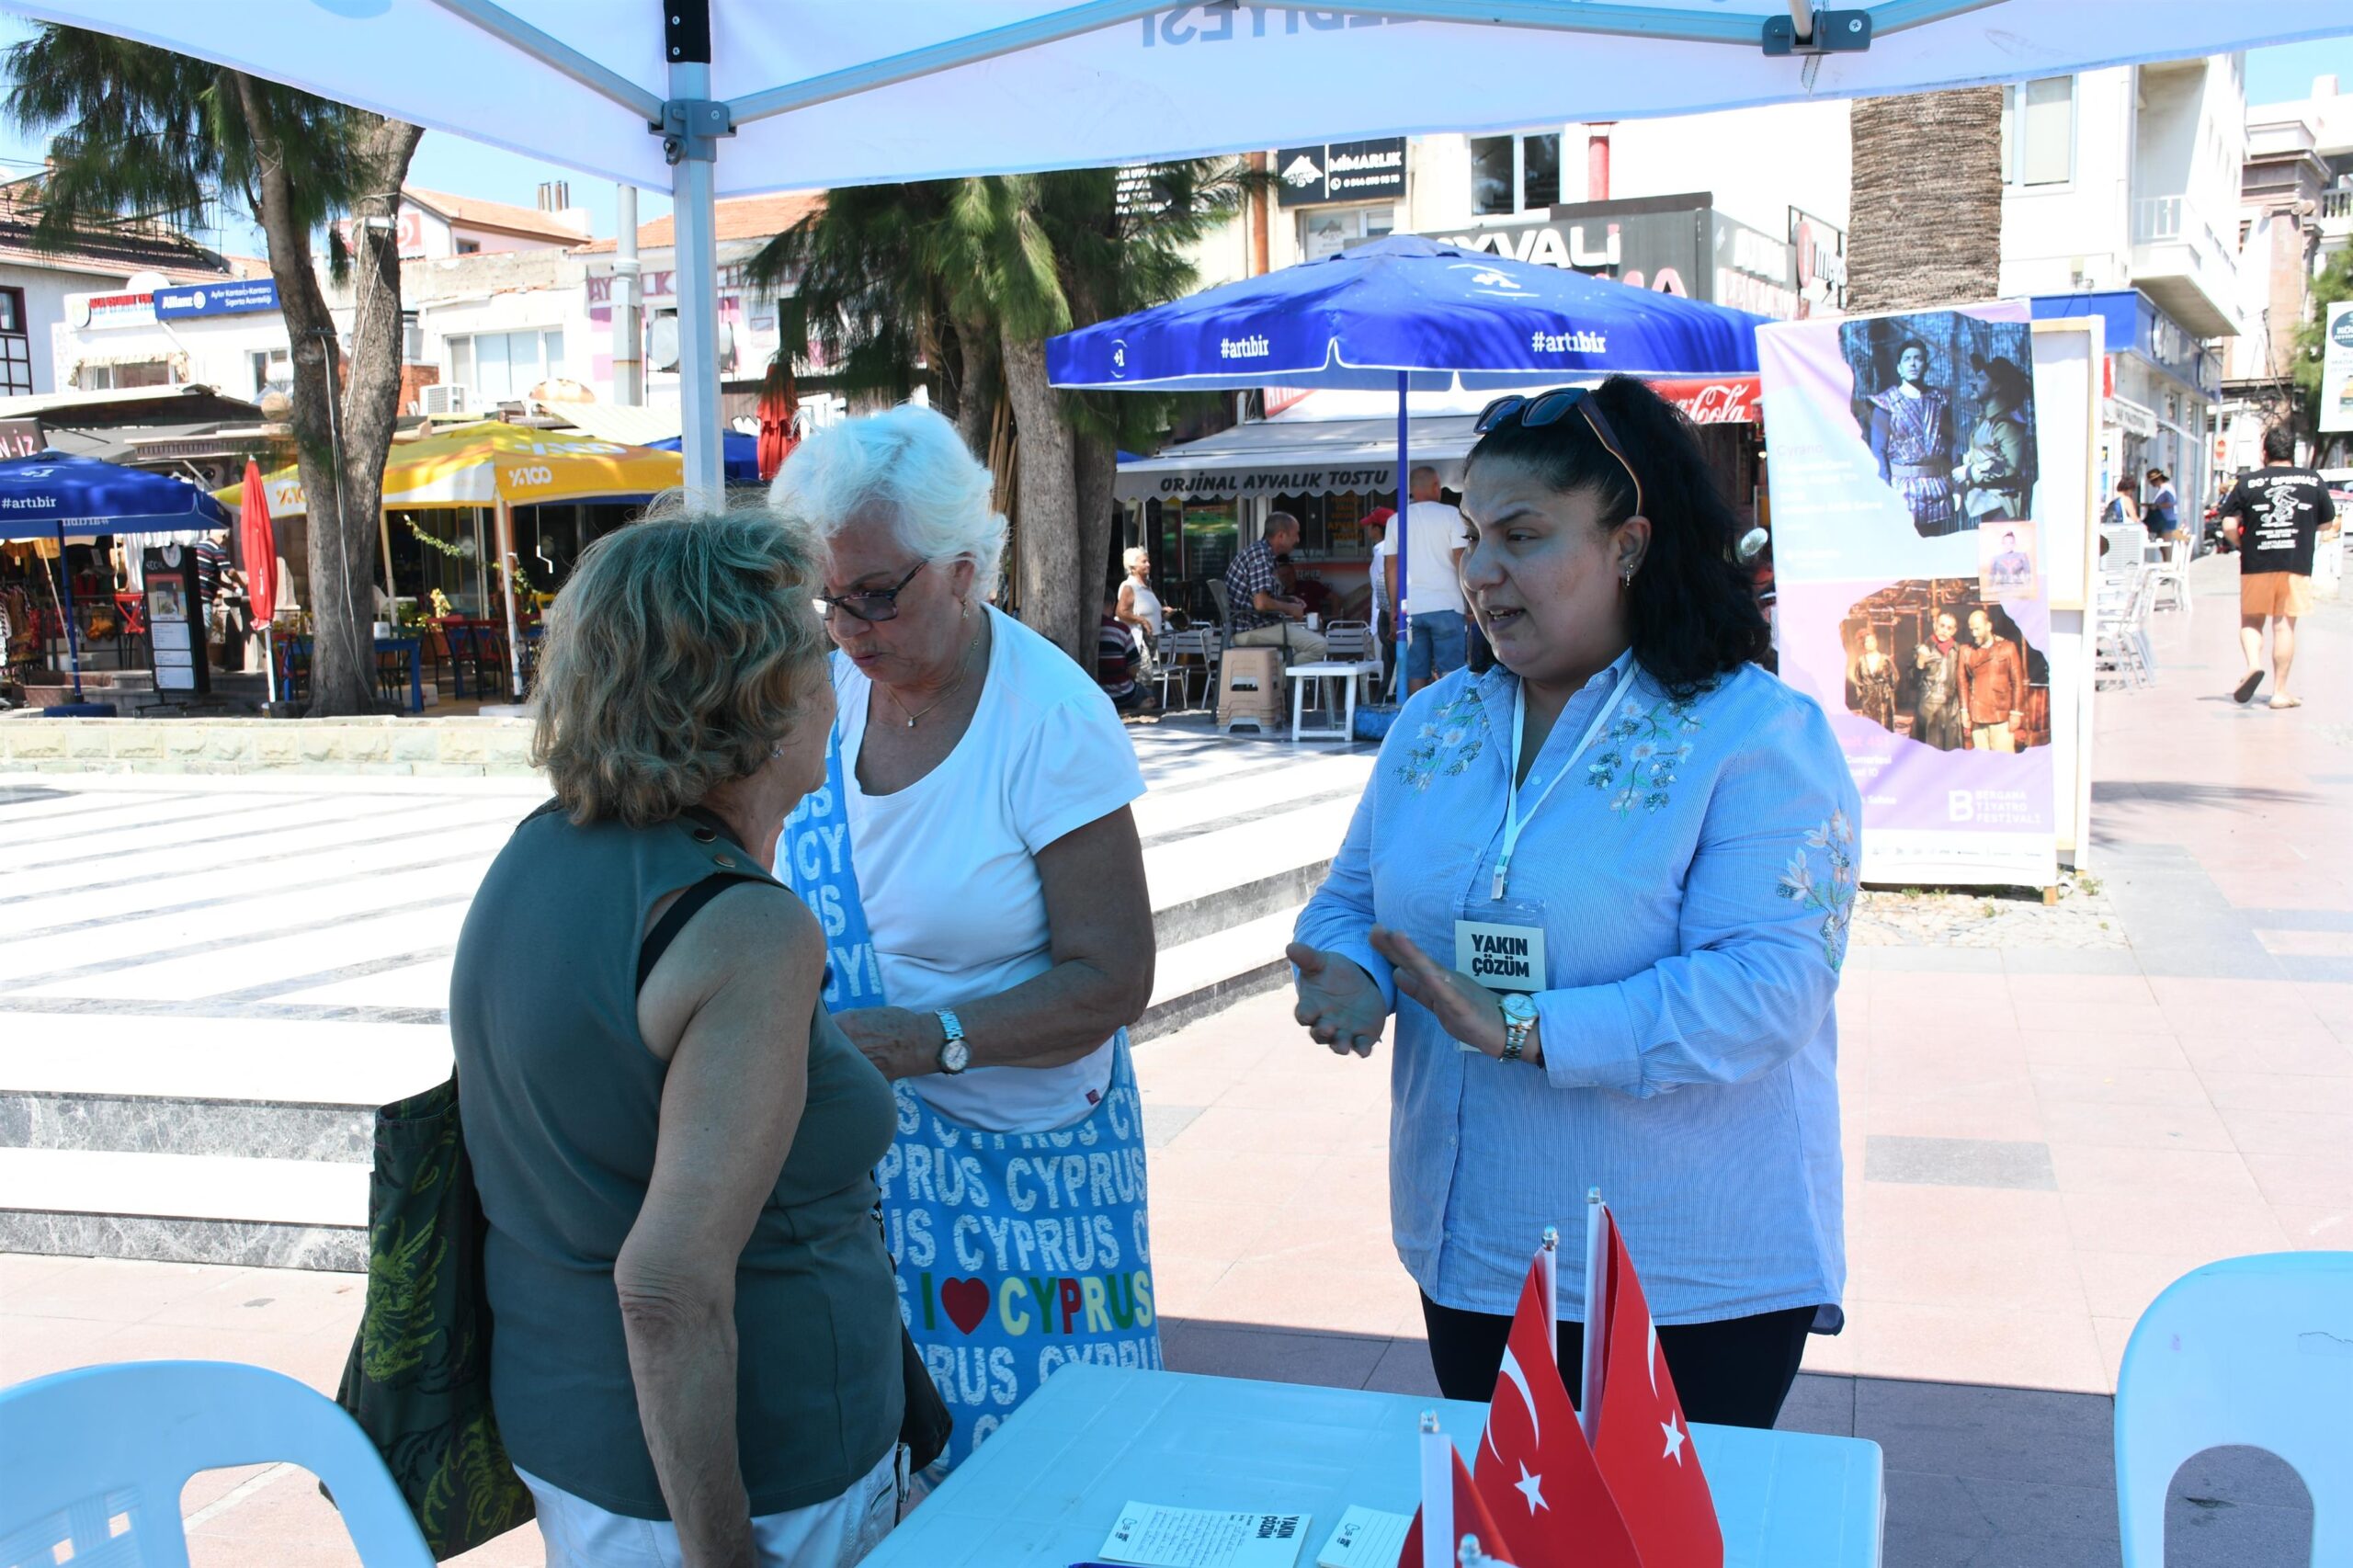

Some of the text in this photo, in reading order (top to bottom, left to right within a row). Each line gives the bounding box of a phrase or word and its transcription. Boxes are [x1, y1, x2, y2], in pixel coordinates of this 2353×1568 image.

[1329, 152, 1402, 173] MİMARLIK
[162, 296, 193, 309] Allianz
[1160, 470, 1388, 492] ORJİNAL AYVALIK TOSTU
[2, 496, 56, 509] #artıbir
[1949, 790, 1974, 822] B
[1975, 790, 2028, 800] BERGAMA
[1975, 801, 2028, 812] TİYATRO
[1976, 812, 2042, 824] FESTİVALİ
[1471, 933, 1529, 957] YAKIN
[1472, 953, 1529, 977] ÇÖZÜM
[1006, 1146, 1147, 1213] CYPRUS
[952, 1213, 1120, 1272] CYPRUS
[920, 1271, 936, 1331] I
[998, 1269, 1154, 1337] CYPRUS
[1276, 1516, 1300, 1539] YAKIN
